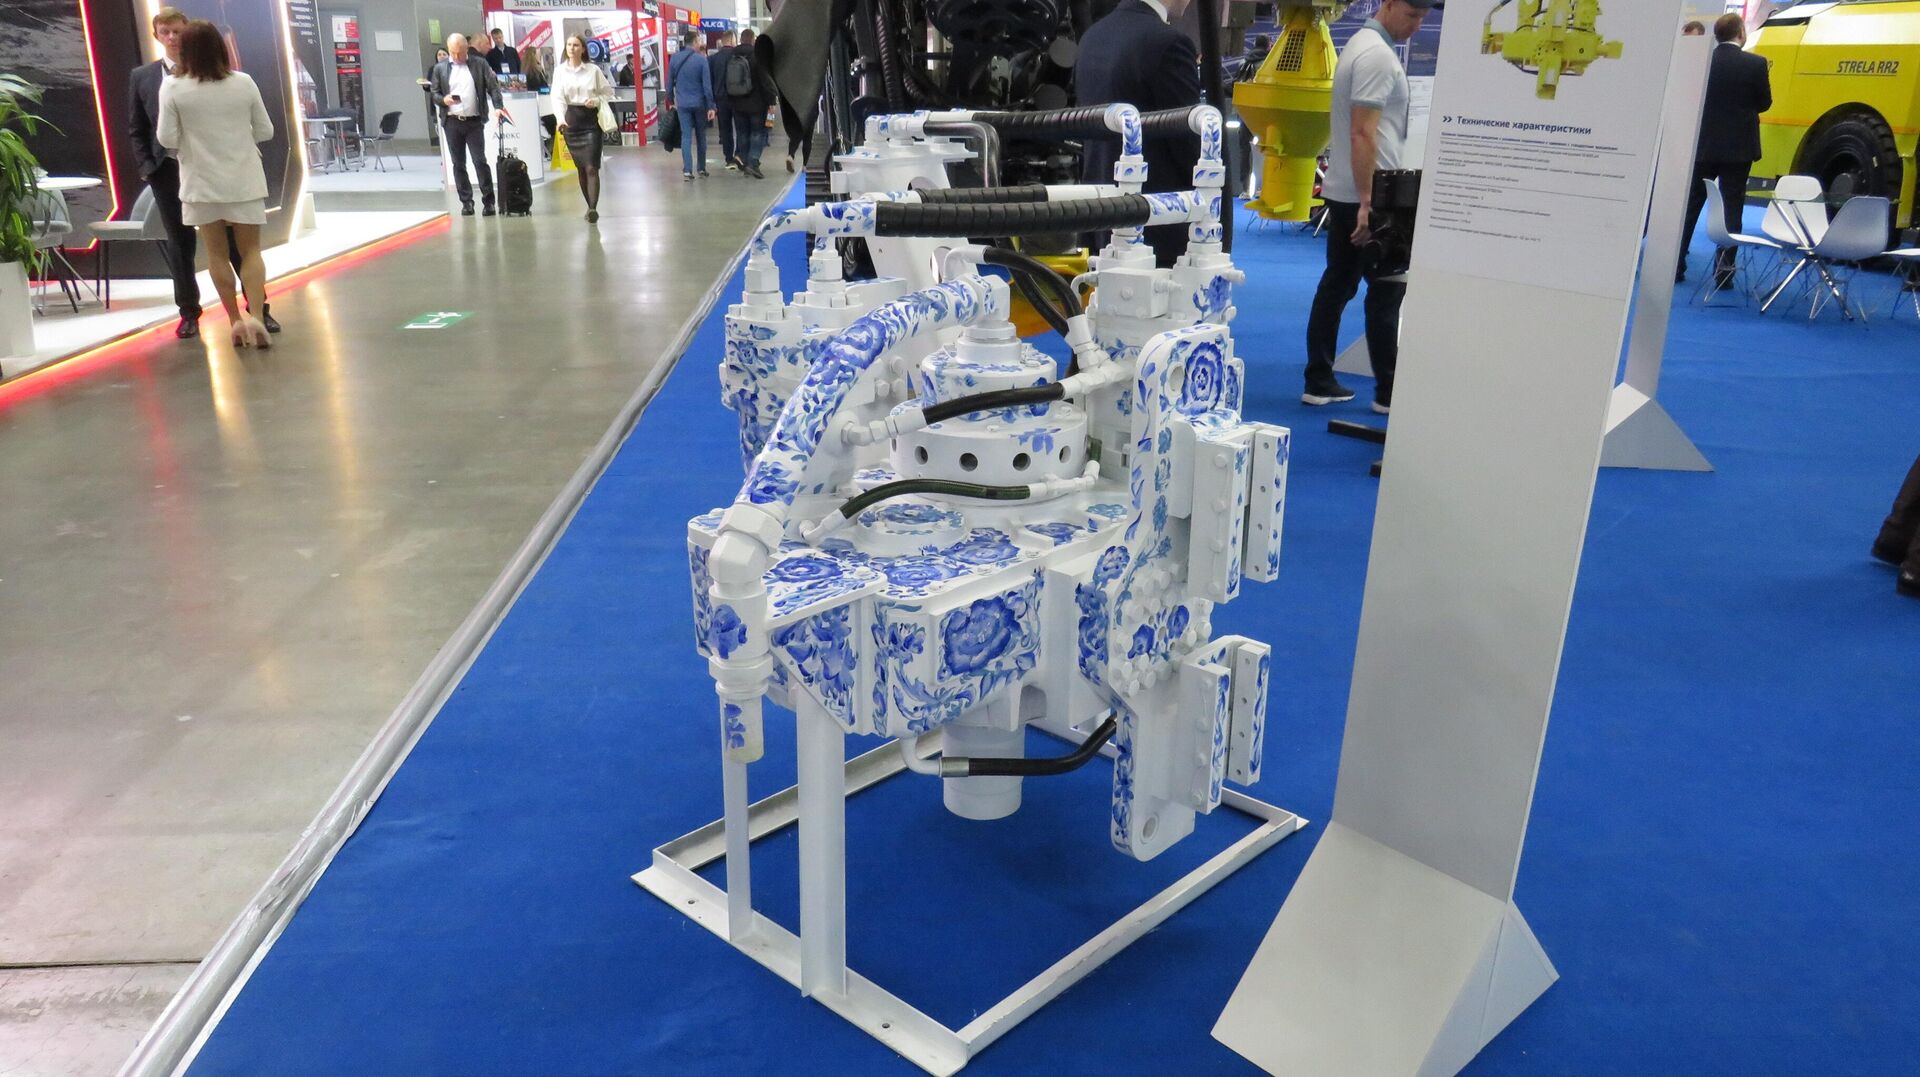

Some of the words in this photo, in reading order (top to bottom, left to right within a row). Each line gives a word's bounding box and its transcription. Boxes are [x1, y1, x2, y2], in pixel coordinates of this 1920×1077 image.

[515, 0, 540, 8] Завод
[1837, 61, 1875, 73] STRELA
[1876, 61, 1899, 73] RR2
[1457, 116, 1511, 129] Технические
[1512, 122, 1592, 135] характеристики
